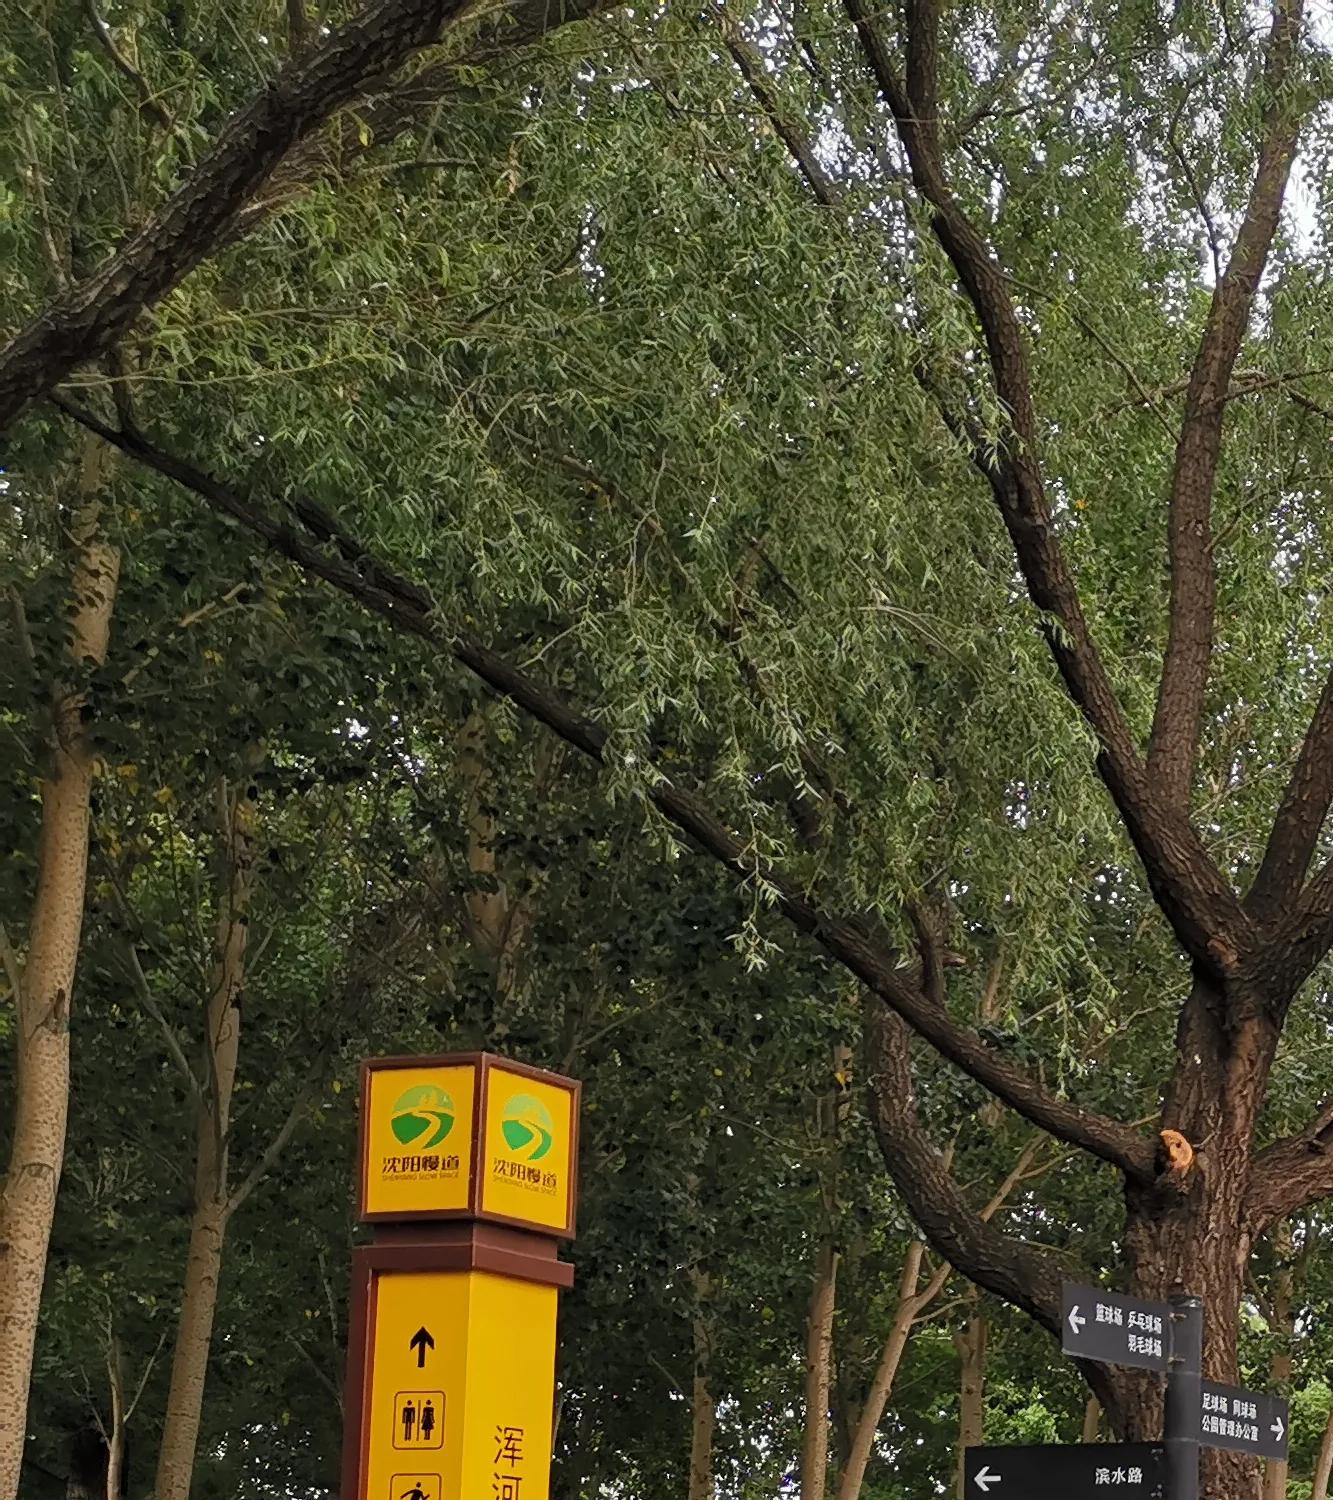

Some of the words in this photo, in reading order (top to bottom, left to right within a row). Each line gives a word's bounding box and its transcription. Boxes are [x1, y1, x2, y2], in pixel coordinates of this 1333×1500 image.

[383, 1155, 460, 1173] 沈阳慢道
[494, 1158, 557, 1187] 沈阳慢道
[1202, 1415, 1259, 1441] 公园管理办公室
[1095, 1466, 1143, 1485] 滨水路
